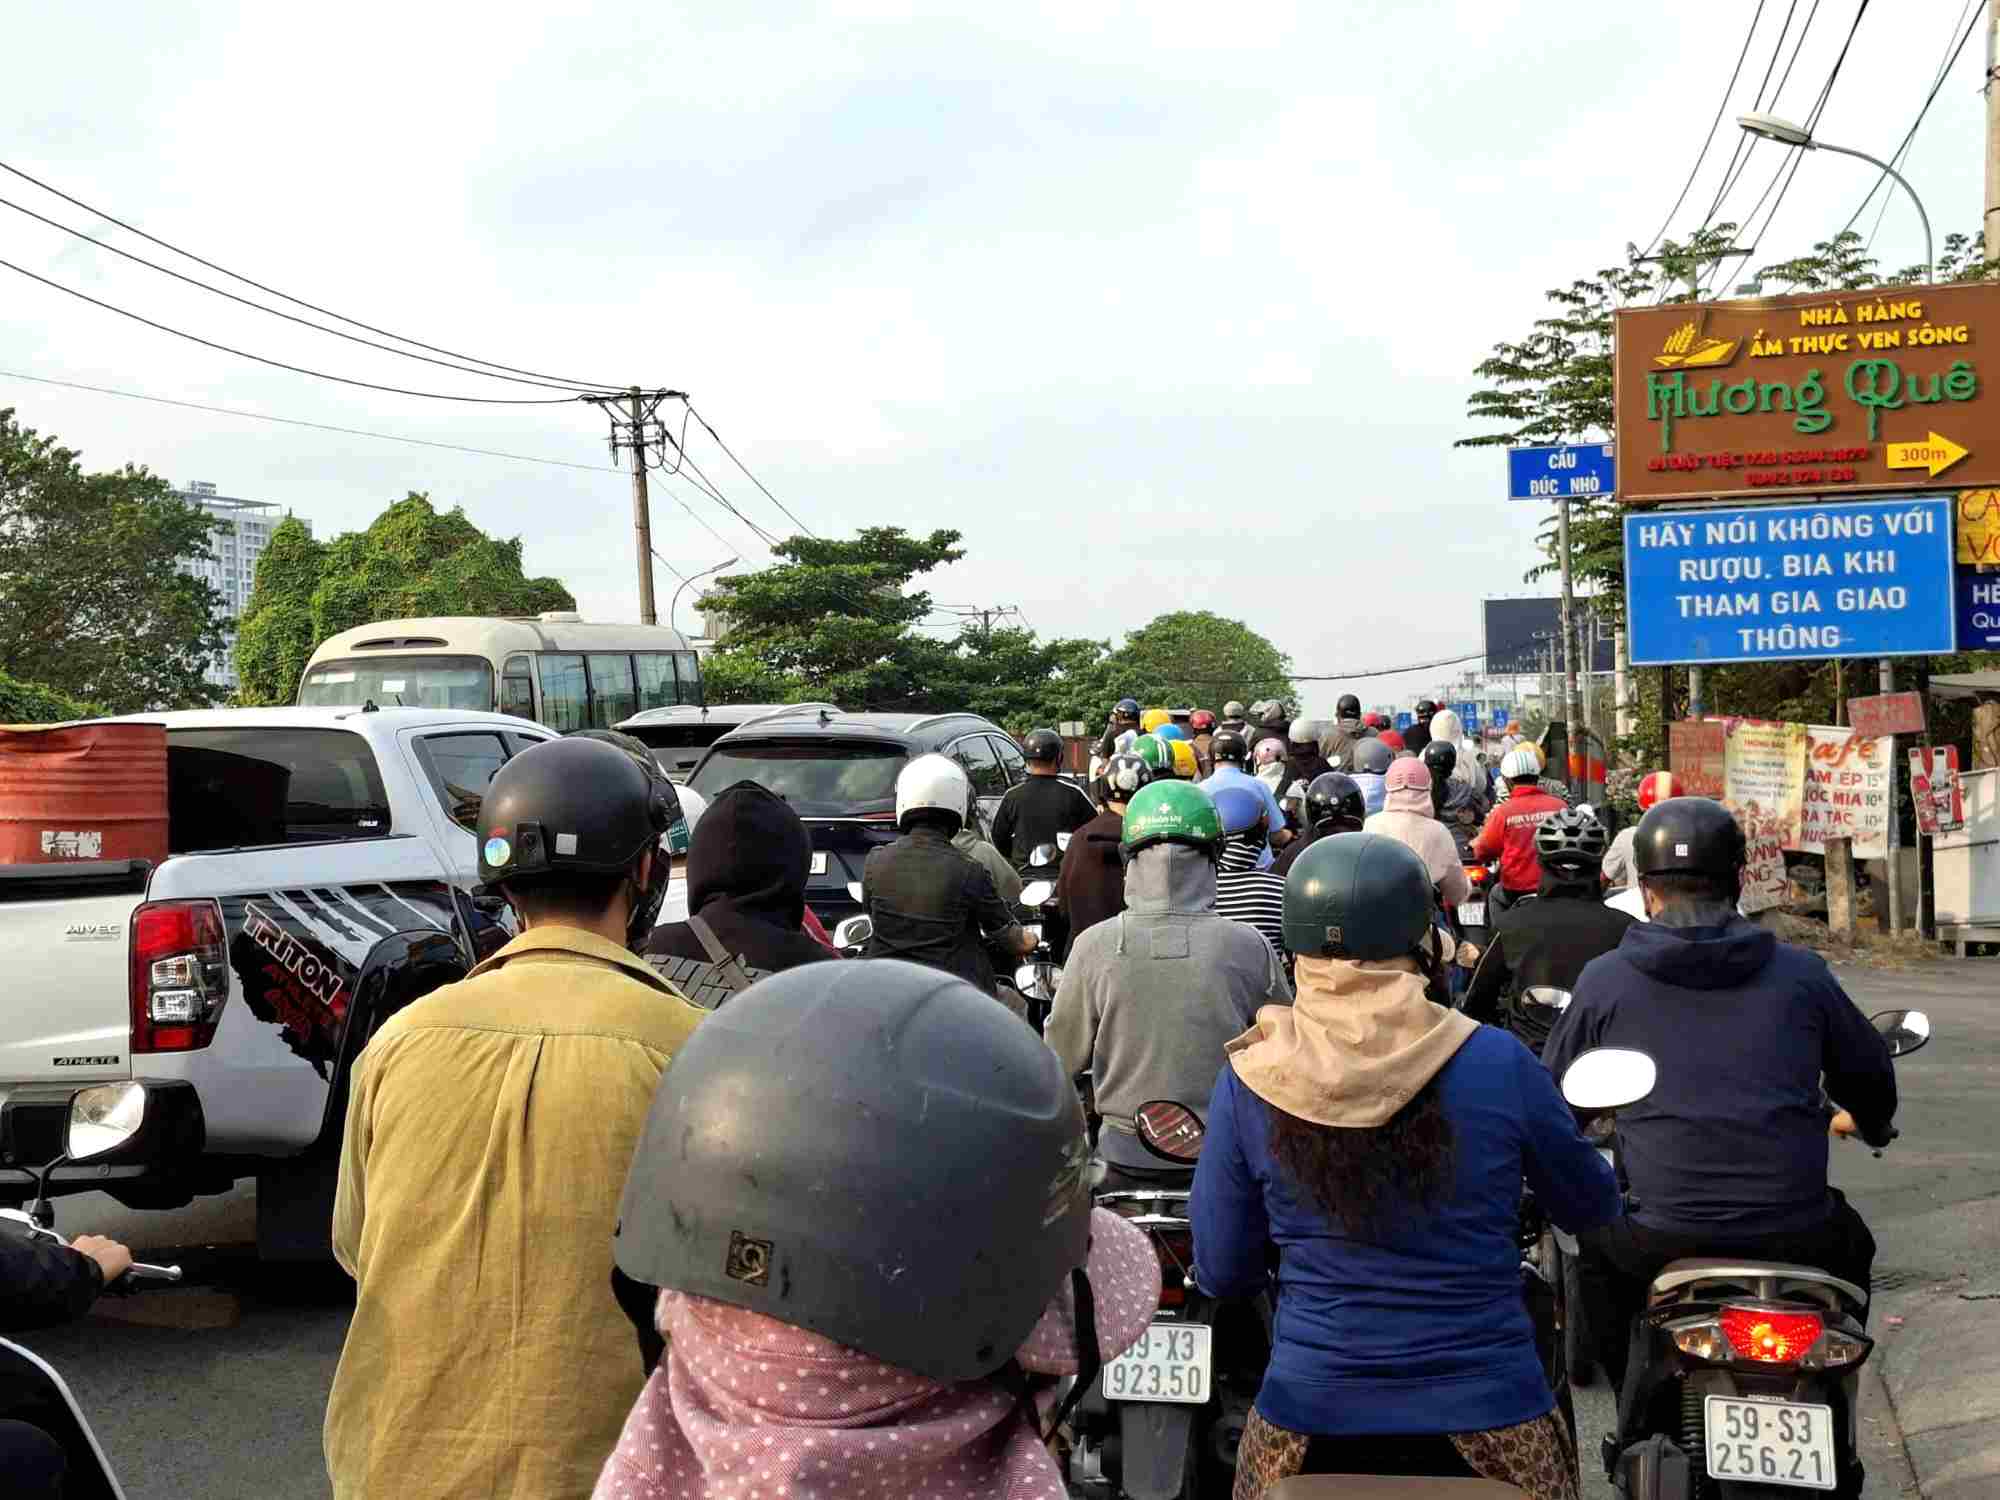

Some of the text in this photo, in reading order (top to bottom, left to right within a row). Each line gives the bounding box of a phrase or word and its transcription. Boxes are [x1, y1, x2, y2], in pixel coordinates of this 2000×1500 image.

[1801, 298, 1922, 326] NHÀ HÀNG
[1856, 328, 1900, 350] VEN
[1907, 322, 1969, 346] SÔNG
[1843, 358, 1977, 441] Quê
[1900, 446, 1947, 463] 300m
[1639, 506, 1934, 548] HÃY NÓI KHÔNG VỚI
[1783, 554, 1833, 578] BIA
[1844, 550, 1896, 575] KHI
[1676, 586, 1907, 618] THAM GIA GIAO
[1737, 624, 1840, 652] THÔNG
[242, 901, 344, 1006] TRITON
[56, 1056, 118, 1066] ATHLETE
[1112, 1363, 1201, 1398] 923.50
[1715, 1442, 1823, 1483] 256.21
